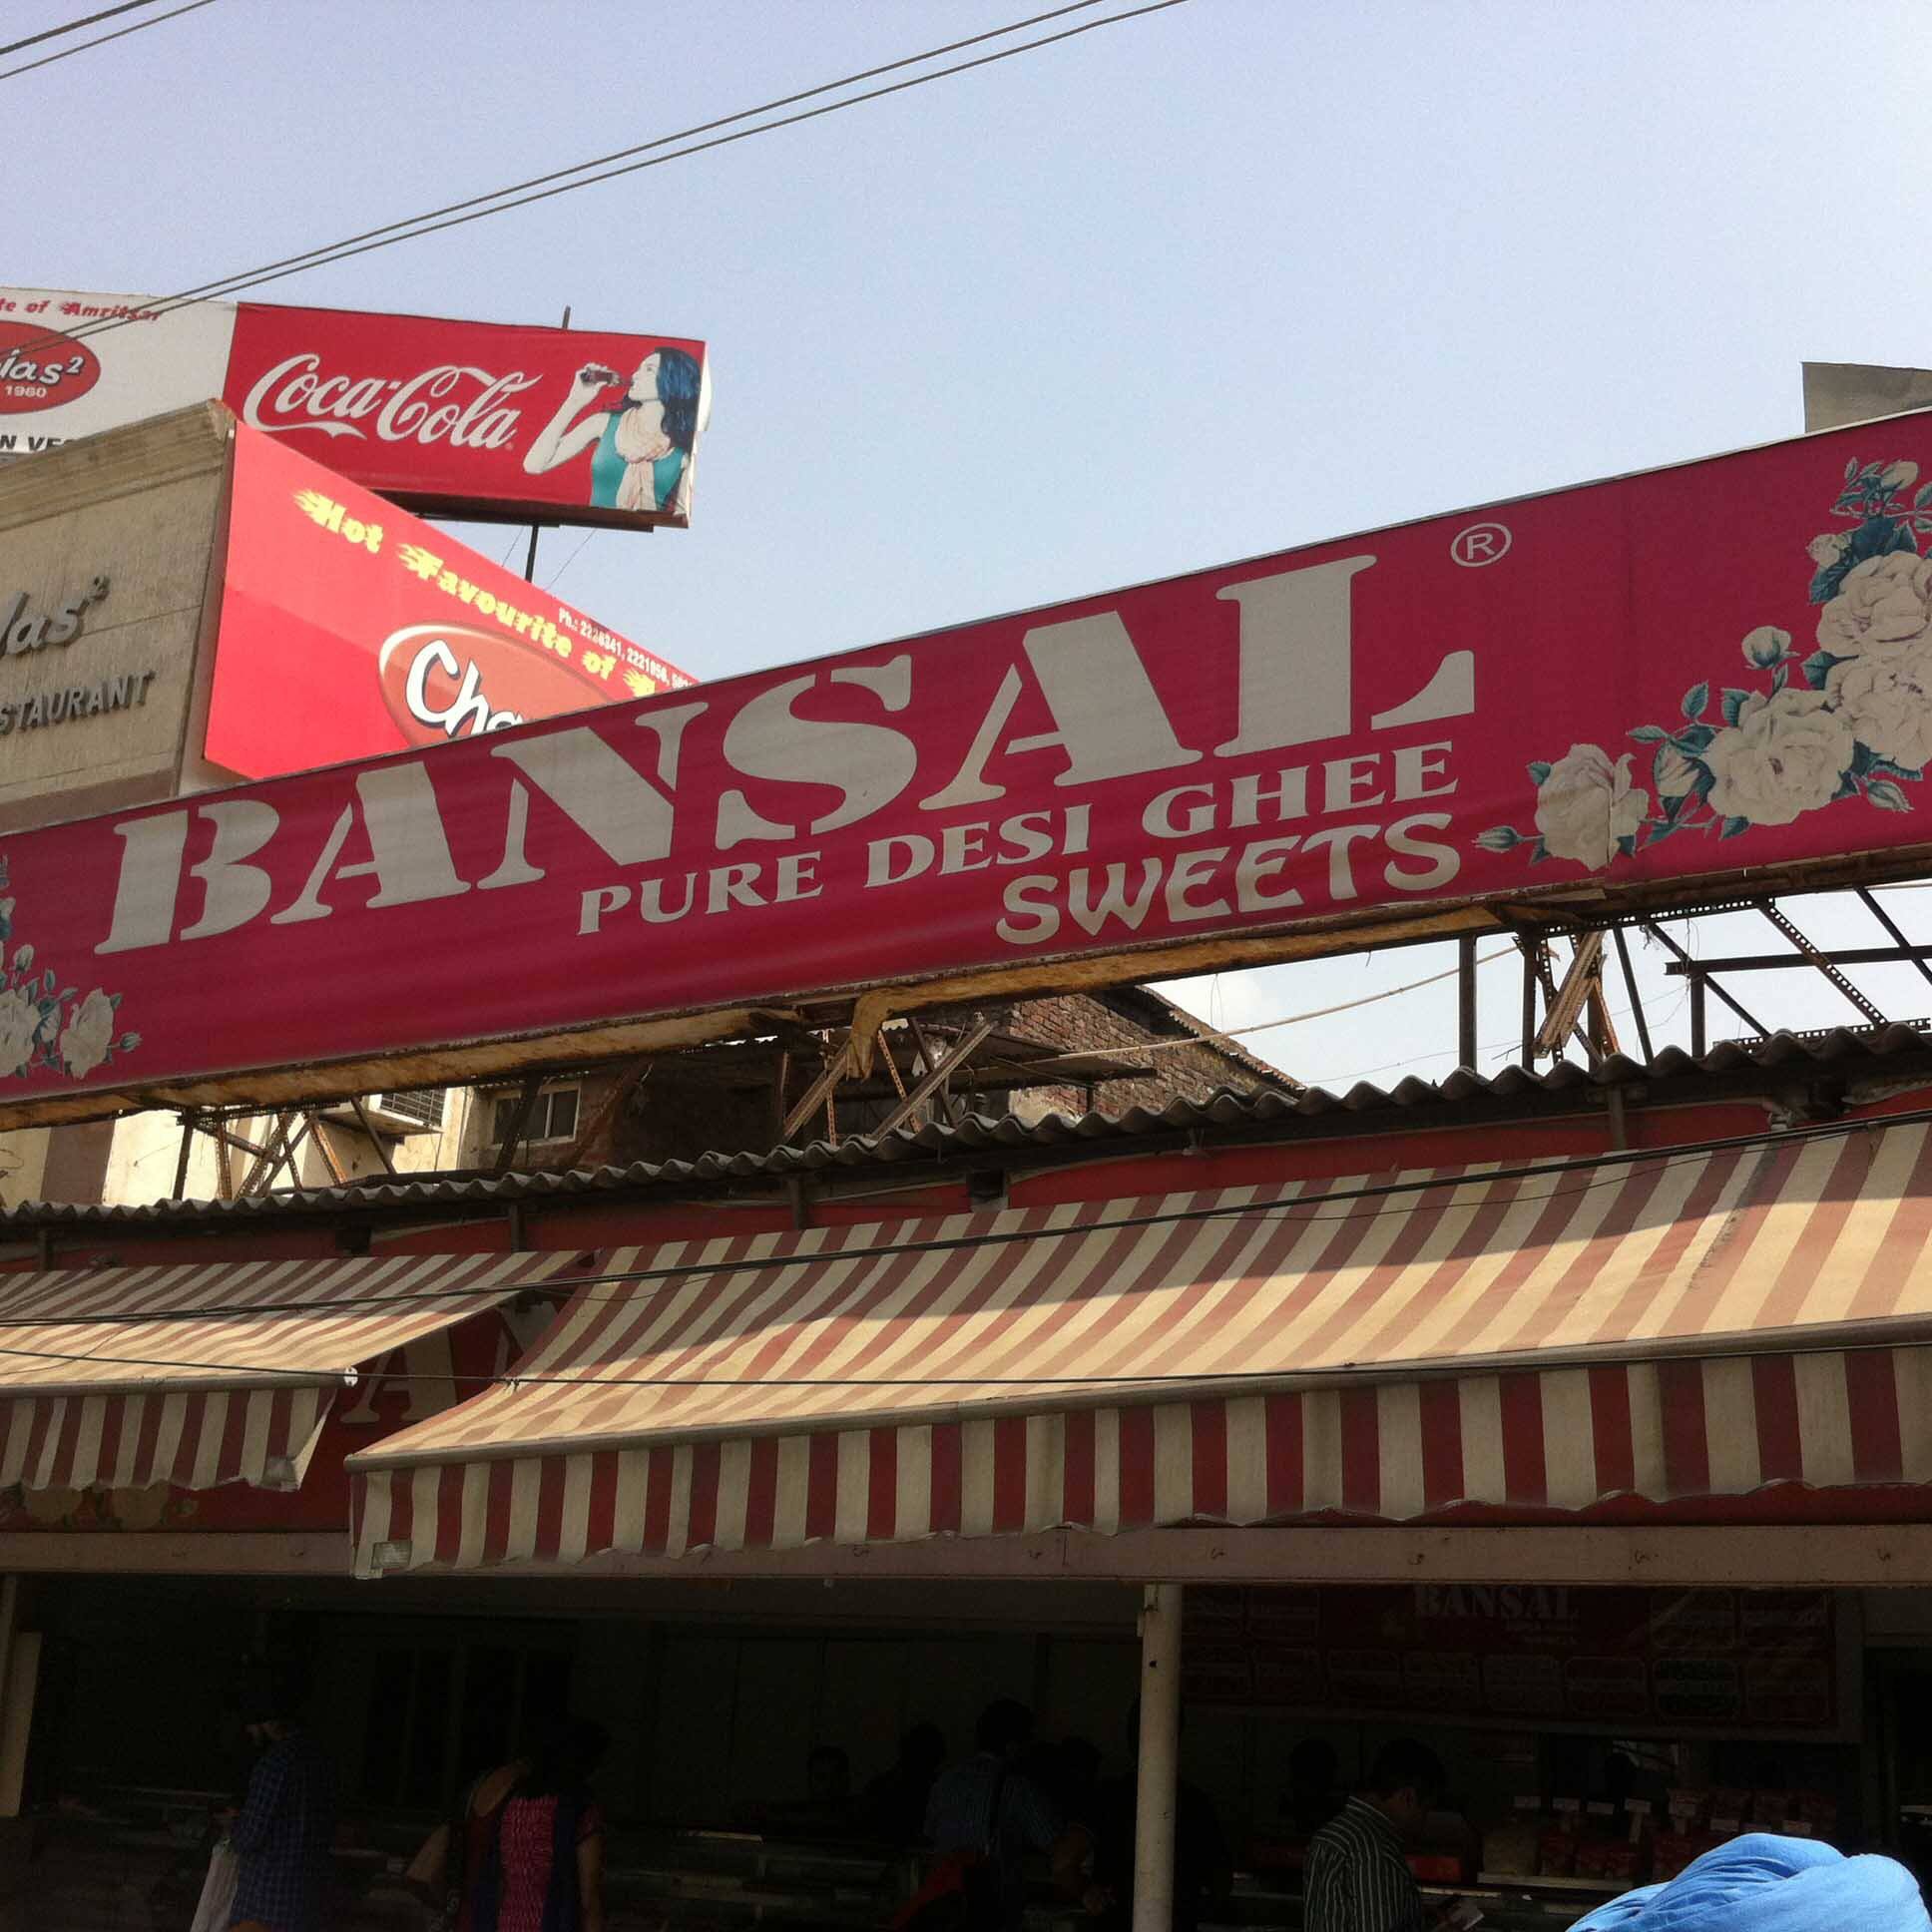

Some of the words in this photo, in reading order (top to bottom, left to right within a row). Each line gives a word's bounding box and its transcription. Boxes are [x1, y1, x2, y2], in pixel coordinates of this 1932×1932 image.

[25, 299, 51, 313] of
[242, 353, 544, 450] Coca-Cola
[293, 489, 383, 554] Hot
[396, 543, 573, 659] Favourite
[583, 650, 618, 682] of
[95, 555, 1476, 955] BANSAL
[578, 850, 824, 936] PURE
[863, 804, 1093, 889] DESI
[1142, 740, 1459, 838] GHEE
[996, 811, 1462, 945] SWEETS
